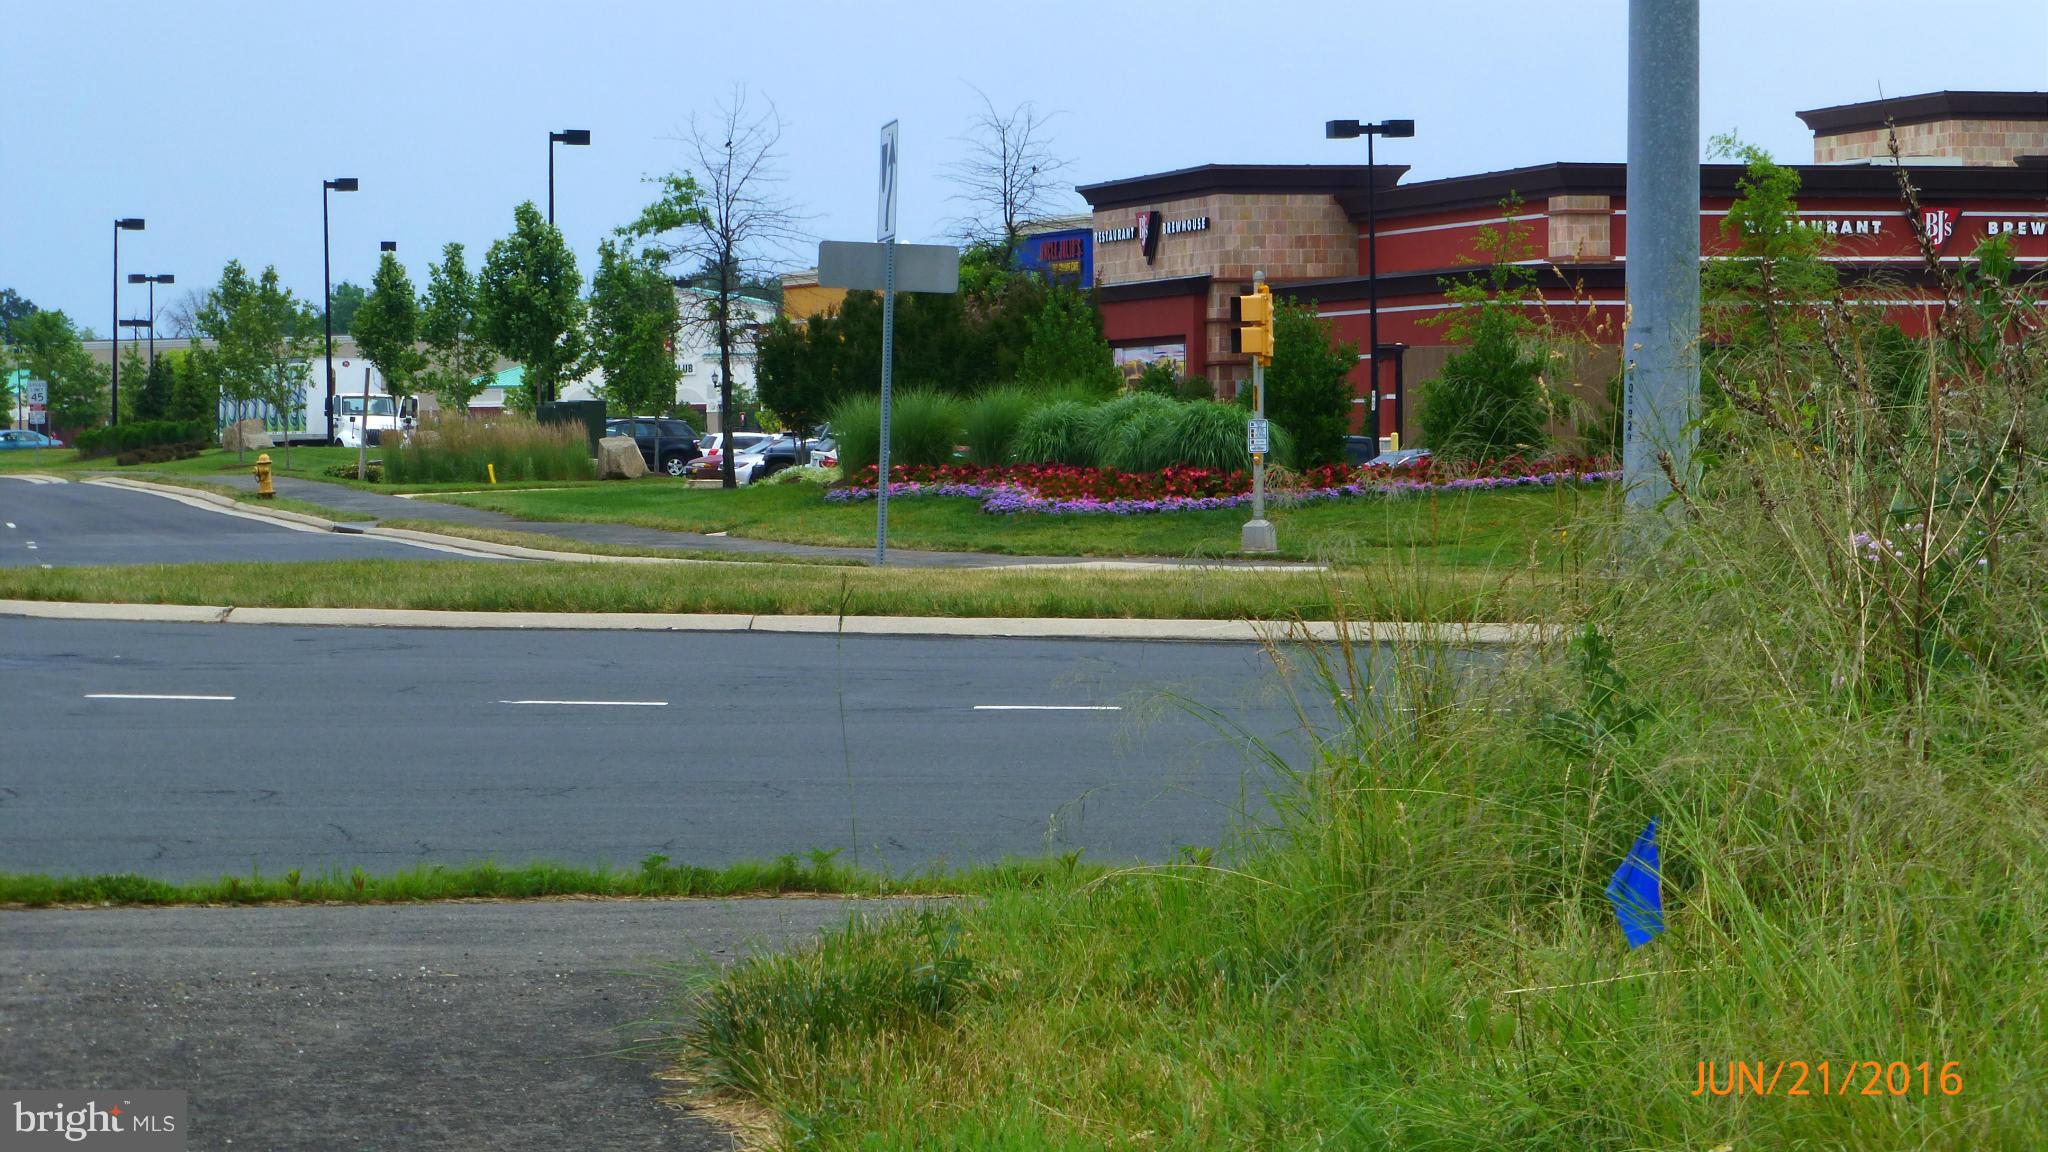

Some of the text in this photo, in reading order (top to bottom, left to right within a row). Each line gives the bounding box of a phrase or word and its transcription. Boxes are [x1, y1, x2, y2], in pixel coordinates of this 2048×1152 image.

[1094, 227, 1136, 244] RESTAURANT
[1162, 216, 1207, 235] BREWHOUSE
[1925, 210, 1952, 245] BJ's
[1988, 221, 2046, 235] BREW
[31, 392, 44, 402] 45
